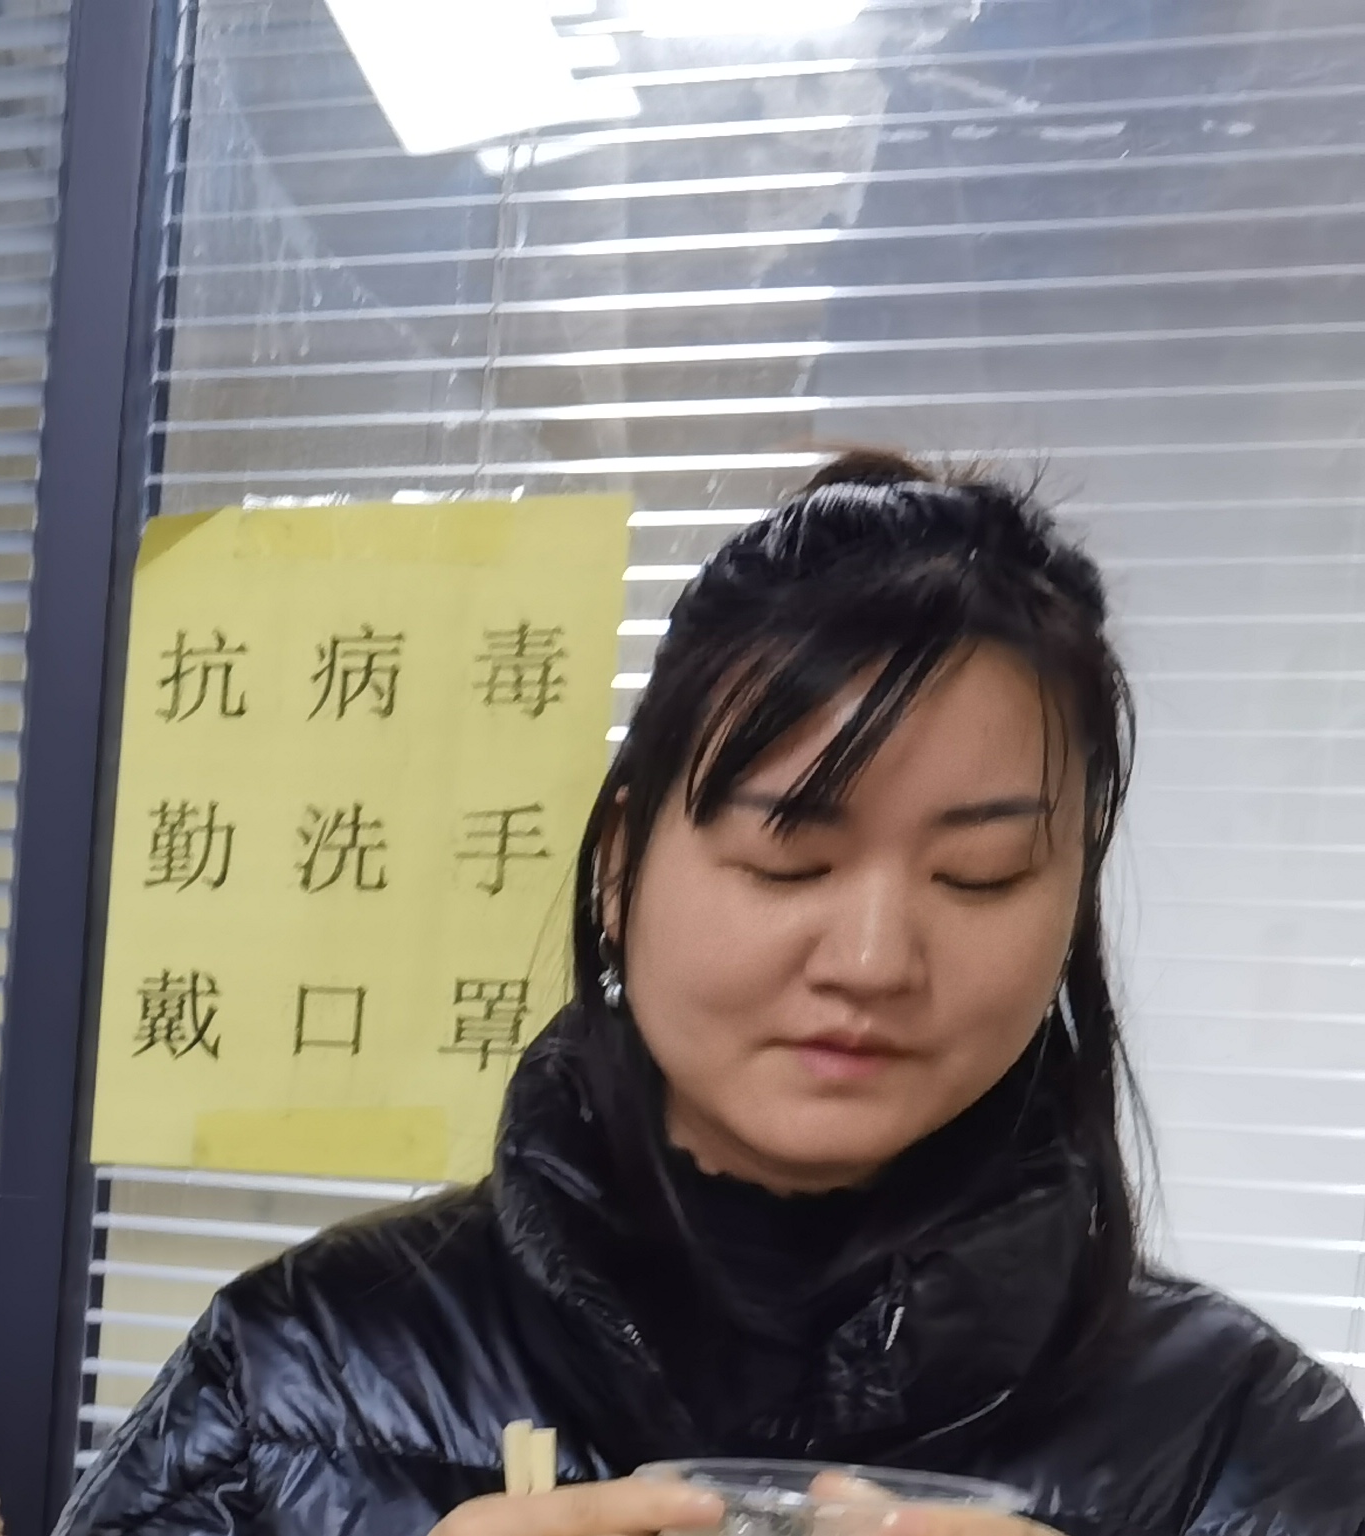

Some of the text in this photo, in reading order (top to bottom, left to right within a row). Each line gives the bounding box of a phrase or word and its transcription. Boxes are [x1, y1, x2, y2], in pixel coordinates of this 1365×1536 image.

[155, 622, 568, 722] 抗病毒
[143, 801, 552, 897] 勤洗手
[132, 968, 527, 1071] 戴口罩
